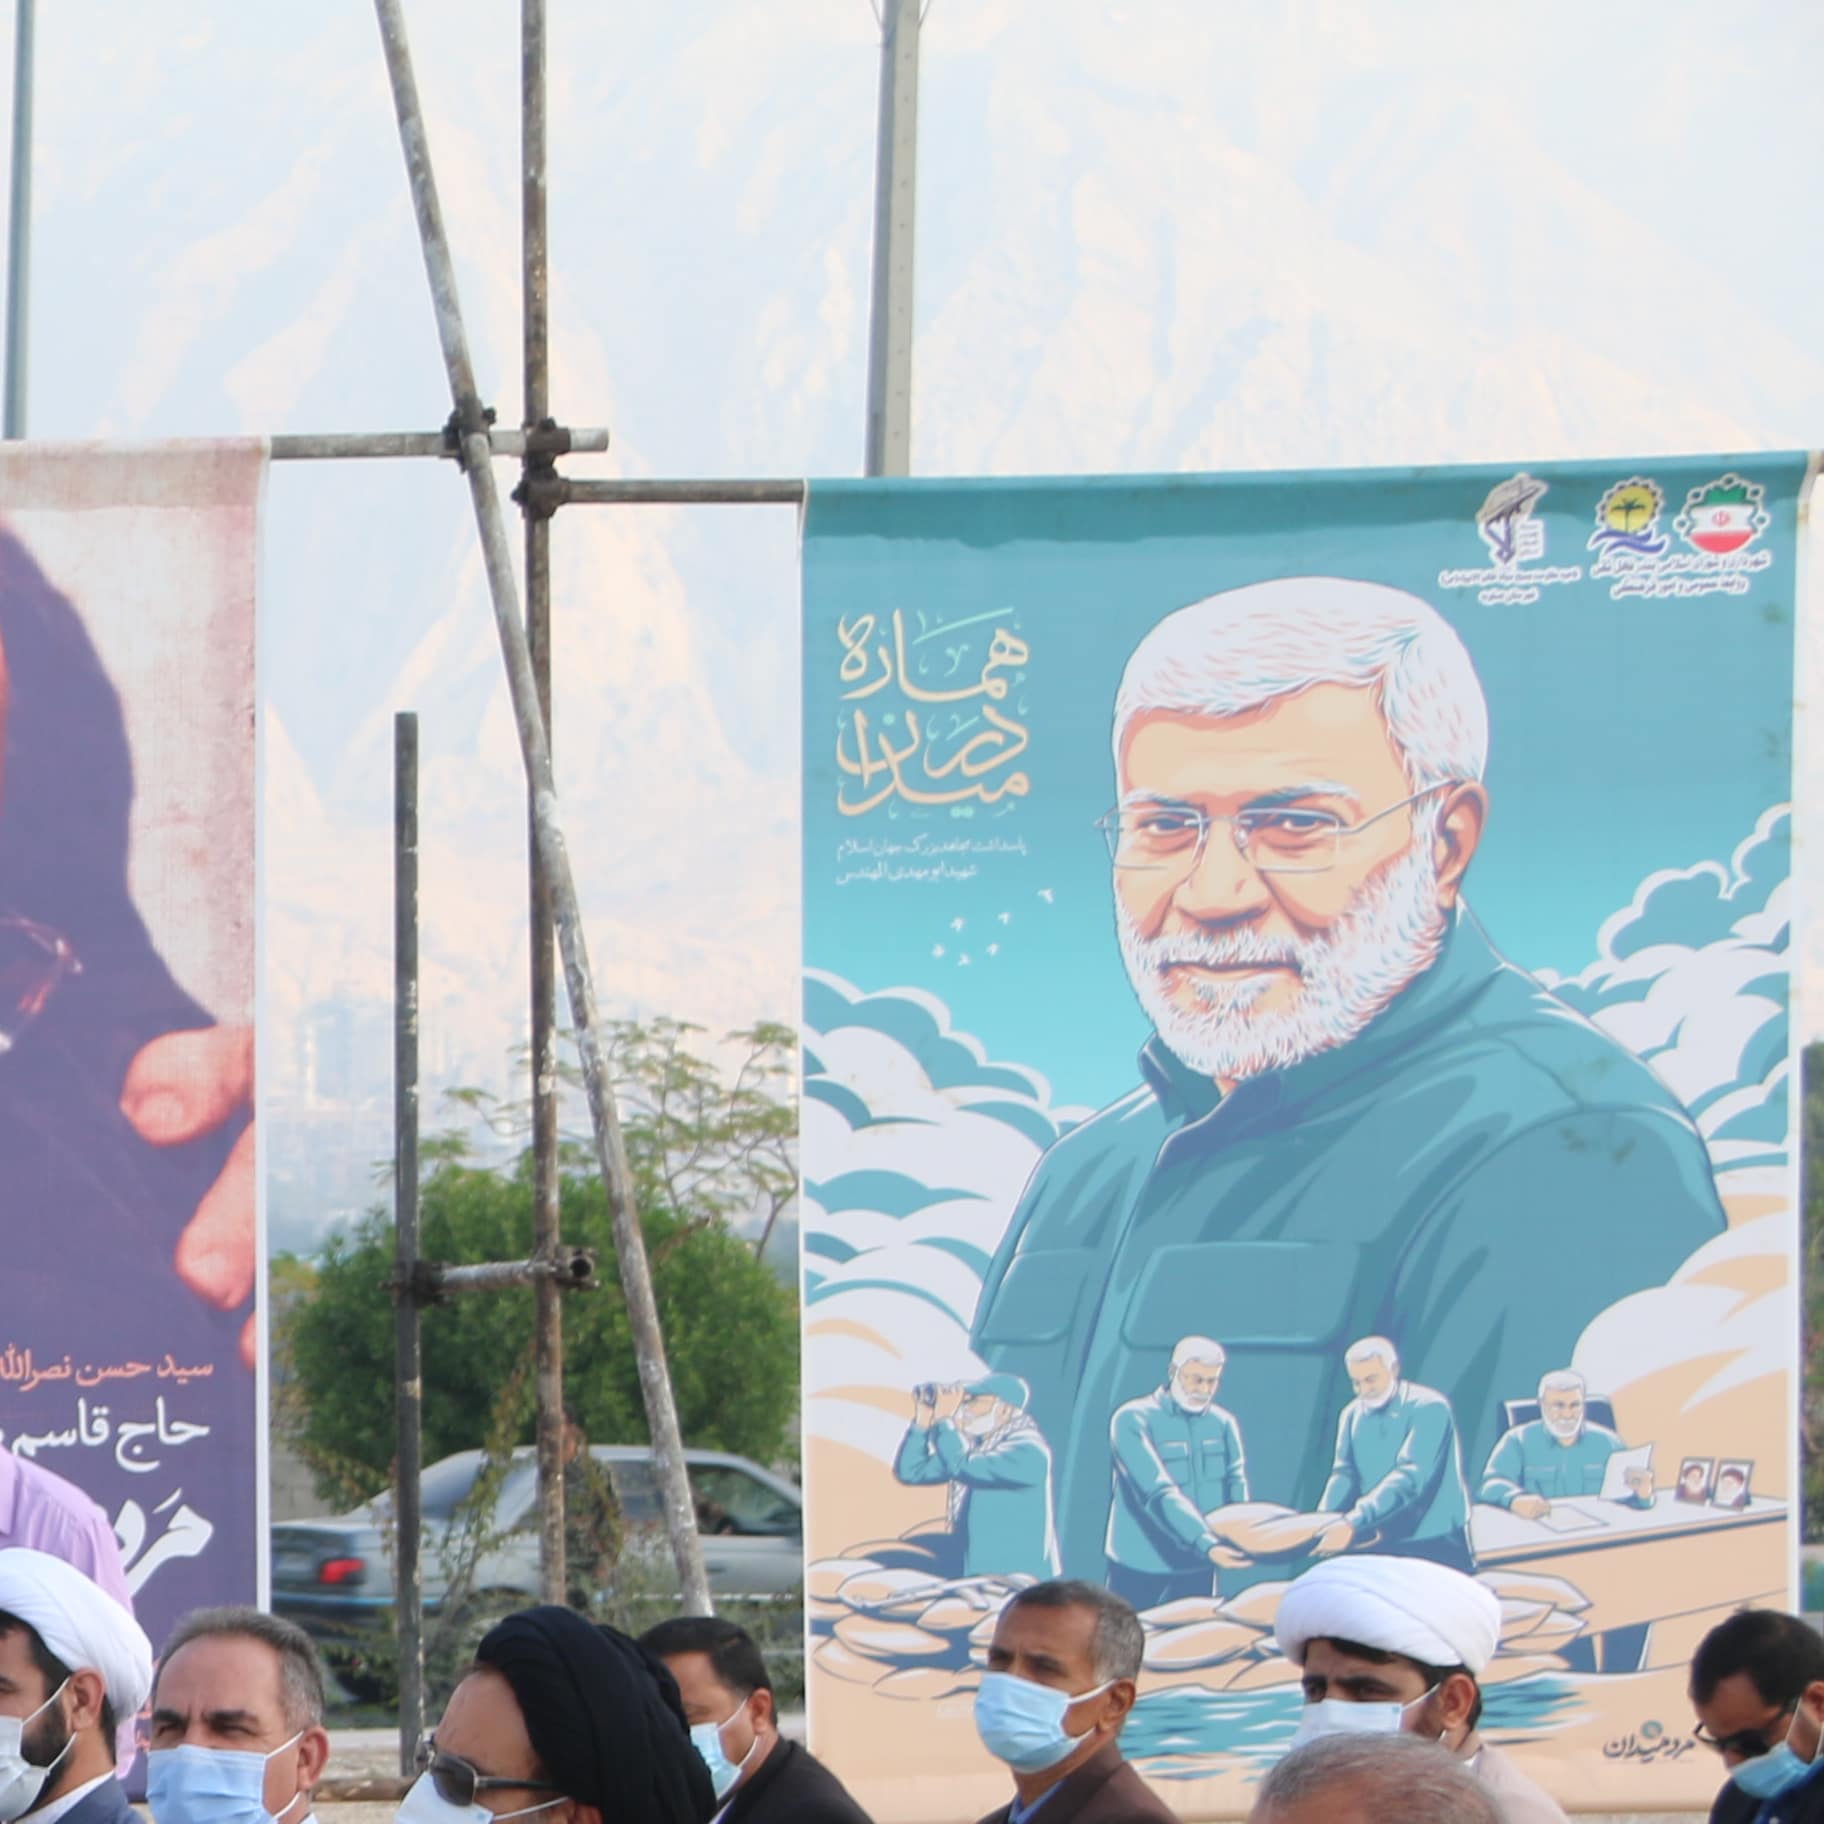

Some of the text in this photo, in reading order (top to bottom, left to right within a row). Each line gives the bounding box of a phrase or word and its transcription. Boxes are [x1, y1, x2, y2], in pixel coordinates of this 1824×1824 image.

[75, 1360, 152, 1387] حسن
[156, 1353, 214, 1385] سید
[12, 1397, 110, 1458] قاسم
[114, 1394, 211, 1473] حاج
[1602, 1733, 1696, 1764] مرد میدان
